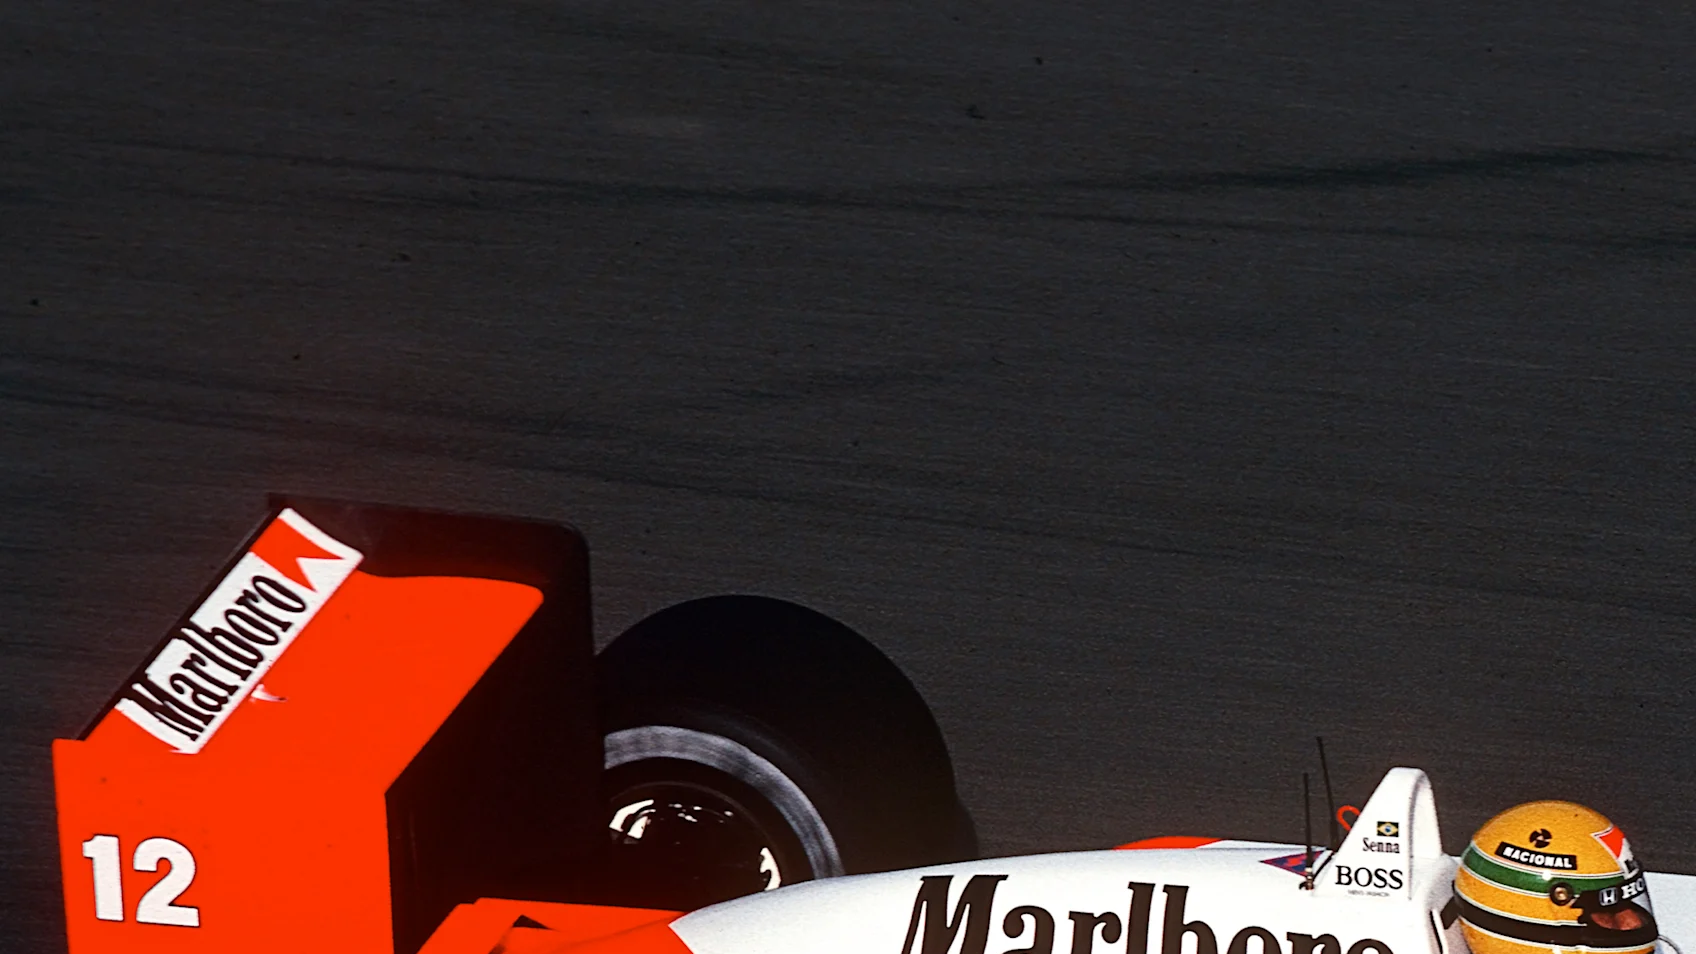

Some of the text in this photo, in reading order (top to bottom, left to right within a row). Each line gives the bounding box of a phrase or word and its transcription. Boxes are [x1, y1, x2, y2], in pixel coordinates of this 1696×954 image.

[131, 575, 308, 742] Marlboro
[1363, 837, 1400, 853] Senna
[1502, 846, 1573, 868] NACIONAL
[82, 834, 200, 928] 12
[1334, 865, 1404, 890] BOSS
